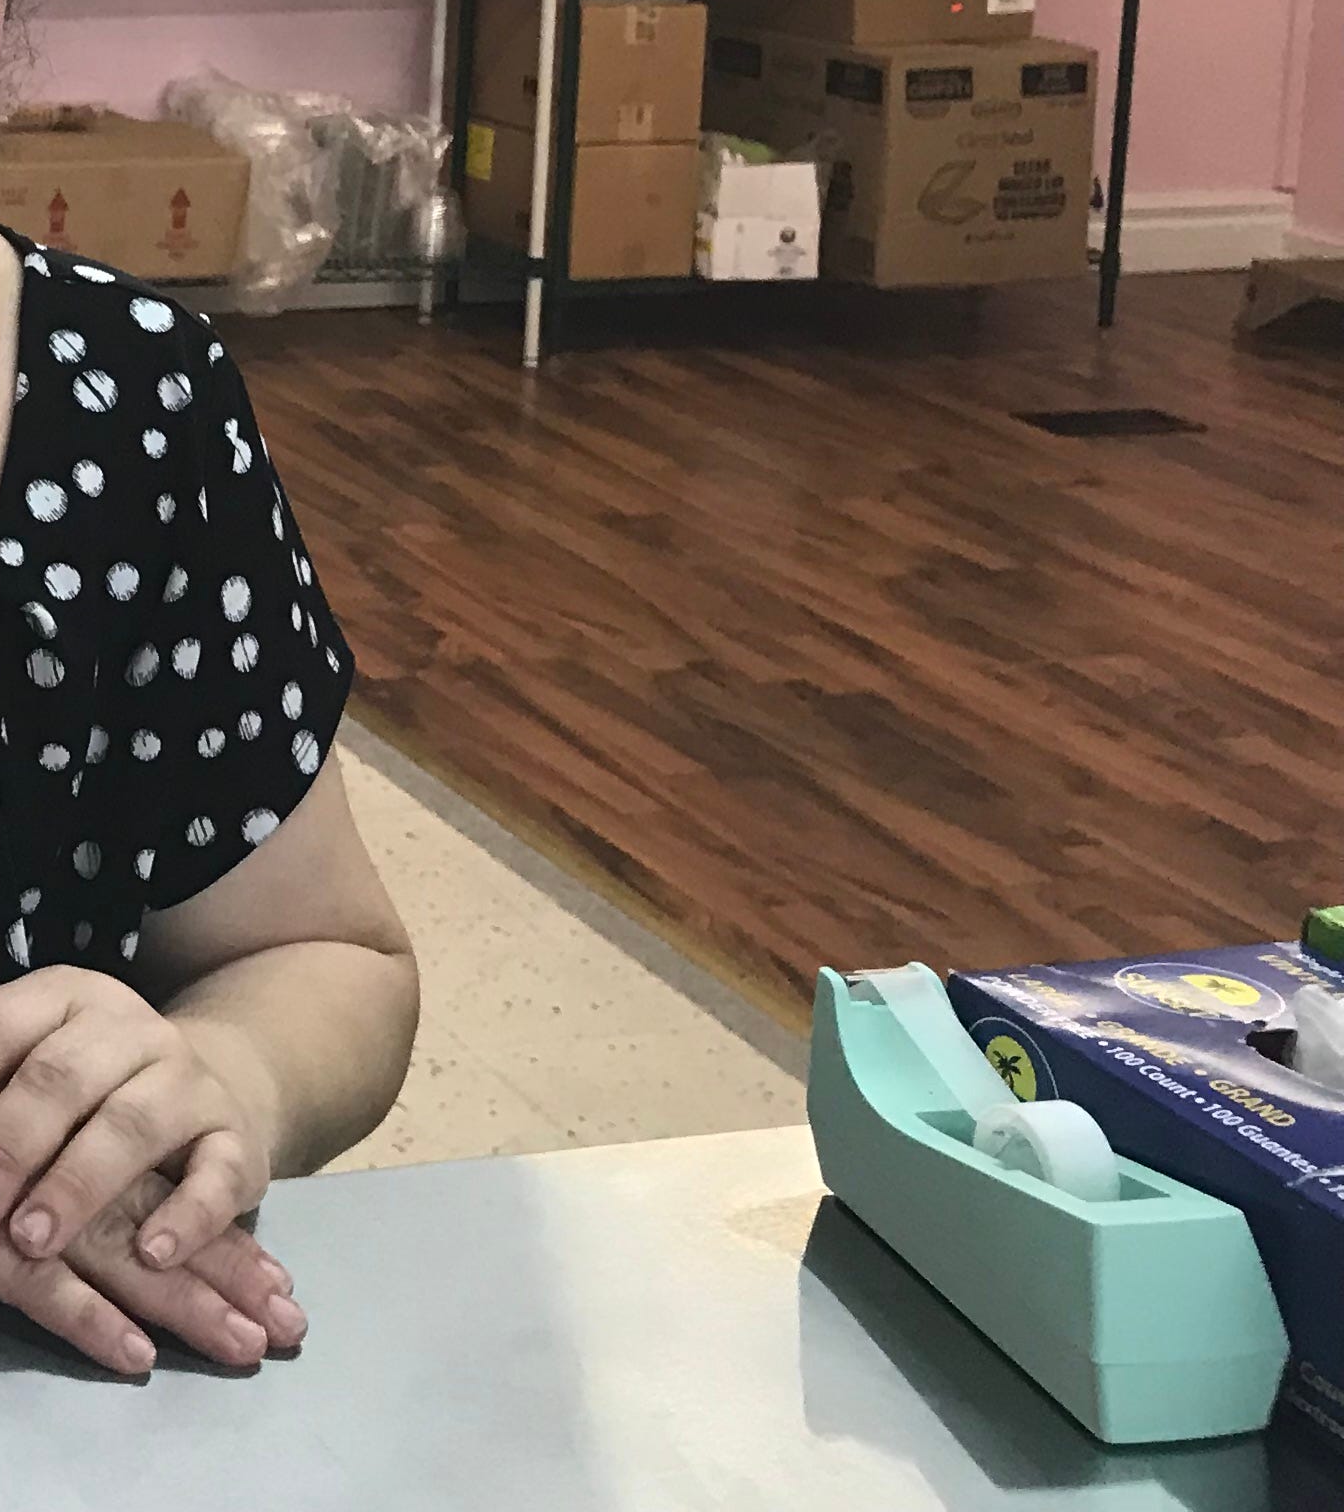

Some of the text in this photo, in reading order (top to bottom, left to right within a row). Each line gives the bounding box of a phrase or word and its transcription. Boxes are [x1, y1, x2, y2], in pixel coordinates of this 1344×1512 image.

[1106, 1045, 1146, 1067] 100
[1138, 1064, 1197, 1099] Count
[1202, 1102, 1245, 1126] 100
[1237, 1123, 1318, 1174] Guantes
[1209, 1079, 1296, 1127] GRAND
